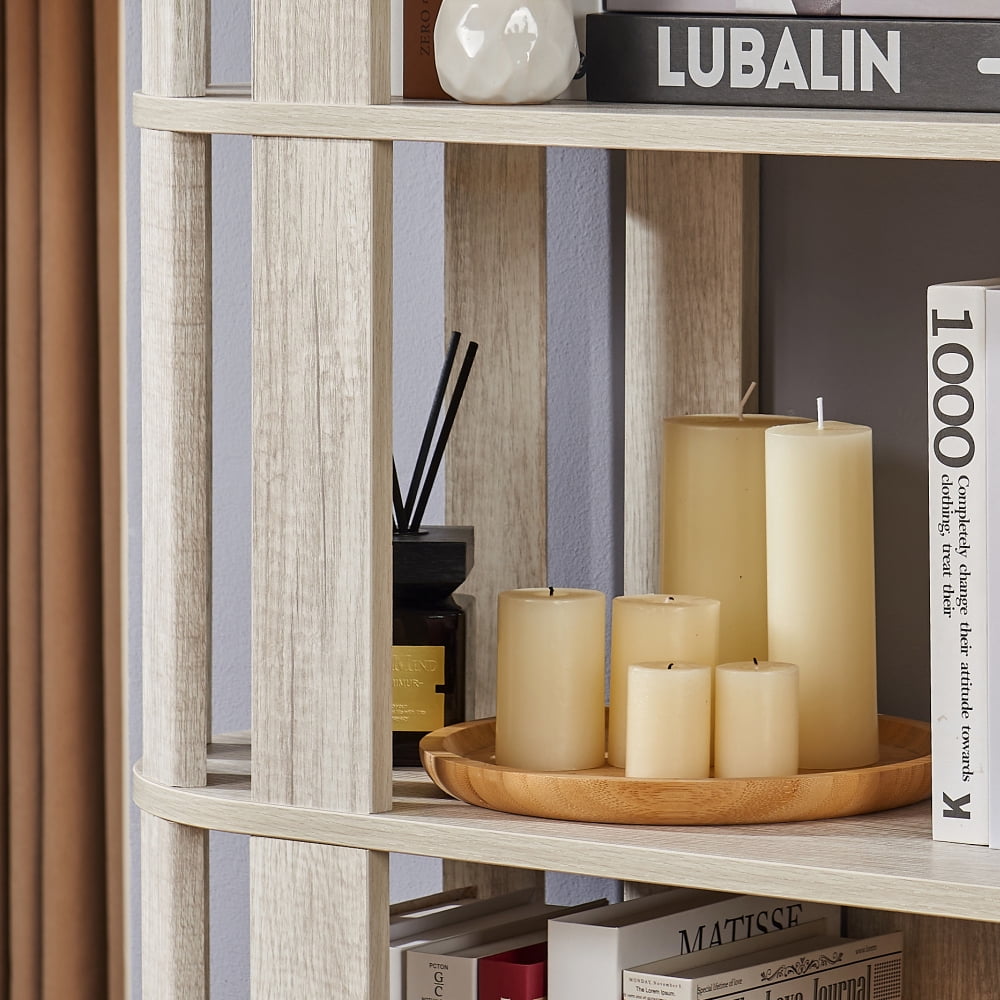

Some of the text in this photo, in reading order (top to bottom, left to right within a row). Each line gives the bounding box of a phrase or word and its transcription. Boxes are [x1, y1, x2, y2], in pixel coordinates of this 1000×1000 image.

[420, 9, 431, 57] ZERO
[658, 26, 901, 94] LUBALIN
[931, 309, 975, 468] 1000
[937, 474, 955, 618] clothing, treat their
[955, 475, 974, 782] Completely change their attitude towards
[943, 791, 971, 820] K
[678, 904, 802, 955] MATISSE
[434, 971, 443, 983] G
[434, 985, 443, 997] C
[697, 983, 713, 994] Special
[813, 965, 872, 1000] Journal
